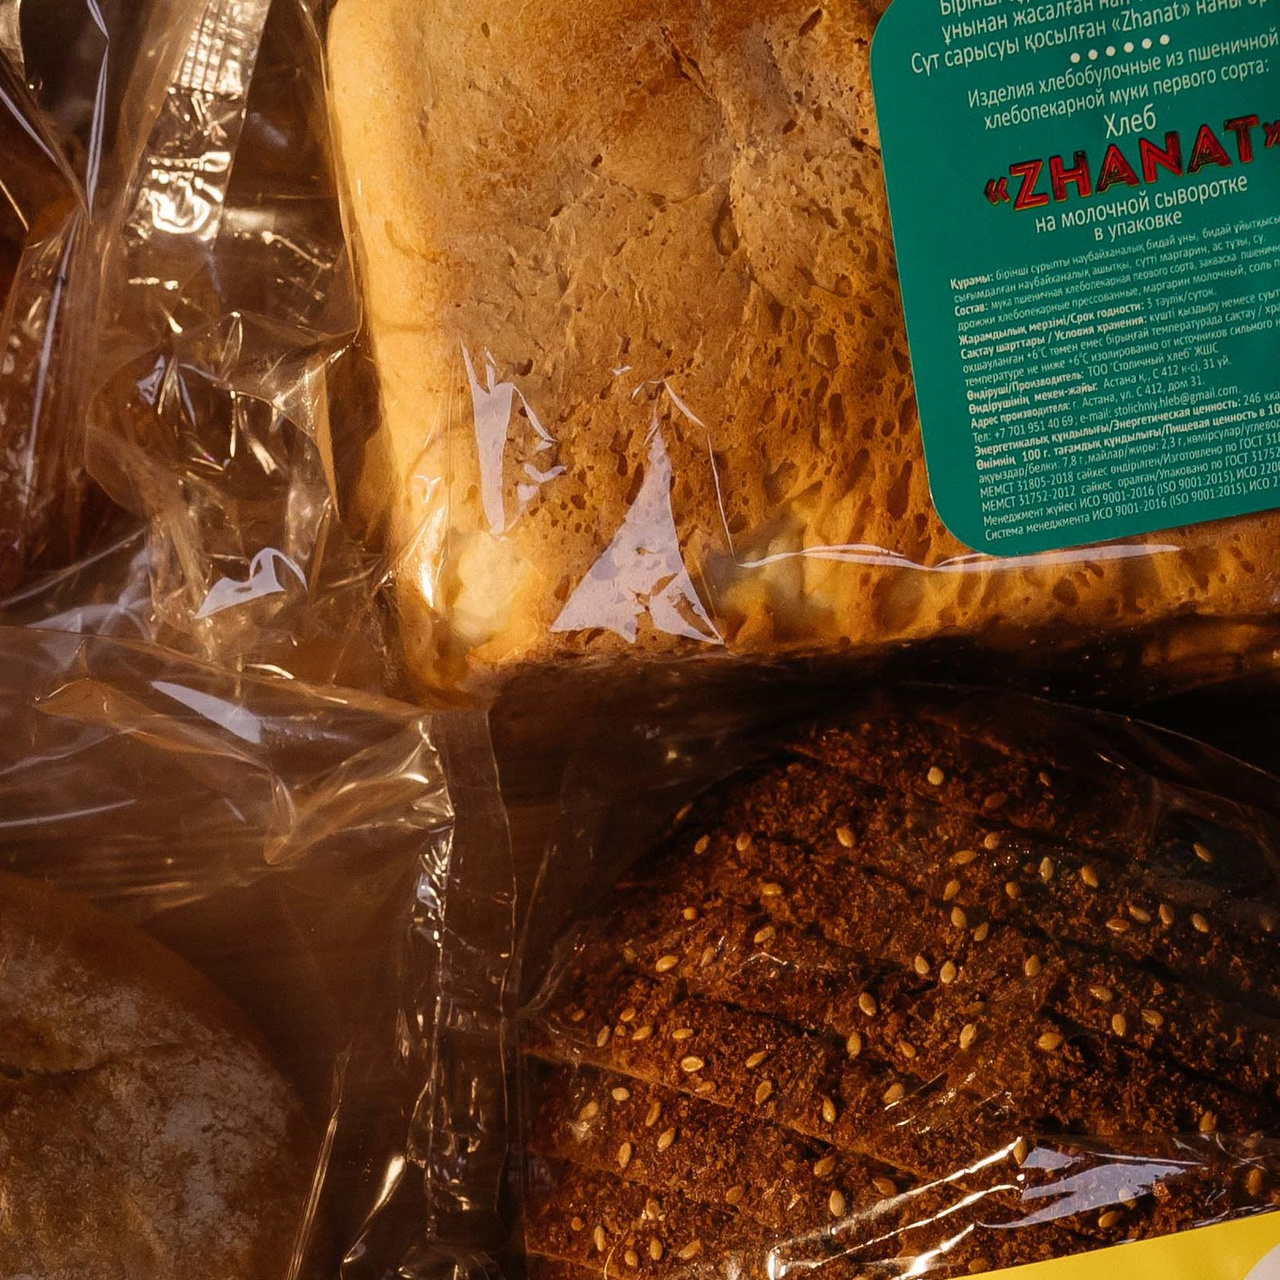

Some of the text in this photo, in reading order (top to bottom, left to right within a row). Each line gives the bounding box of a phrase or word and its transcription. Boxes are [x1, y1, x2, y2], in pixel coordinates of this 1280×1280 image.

[909, 0, 1192, 78] Сүт сарысуы қосылған «Zhanat»
[940, 12, 1009, 47] ұнынан
[966, 25, 1280, 110] Изделия хлебобулочные из пшеничной
[982, 57, 1270, 131] хлебопекарной муки первого сорта:
[1102, 101, 1157, 140] Хлеб
[1034, 174, 1249, 235] на молочной сыворотке
[1092, 209, 1183, 244] в упаковке
[983, 512, 1091, 542] Система менеджмента
